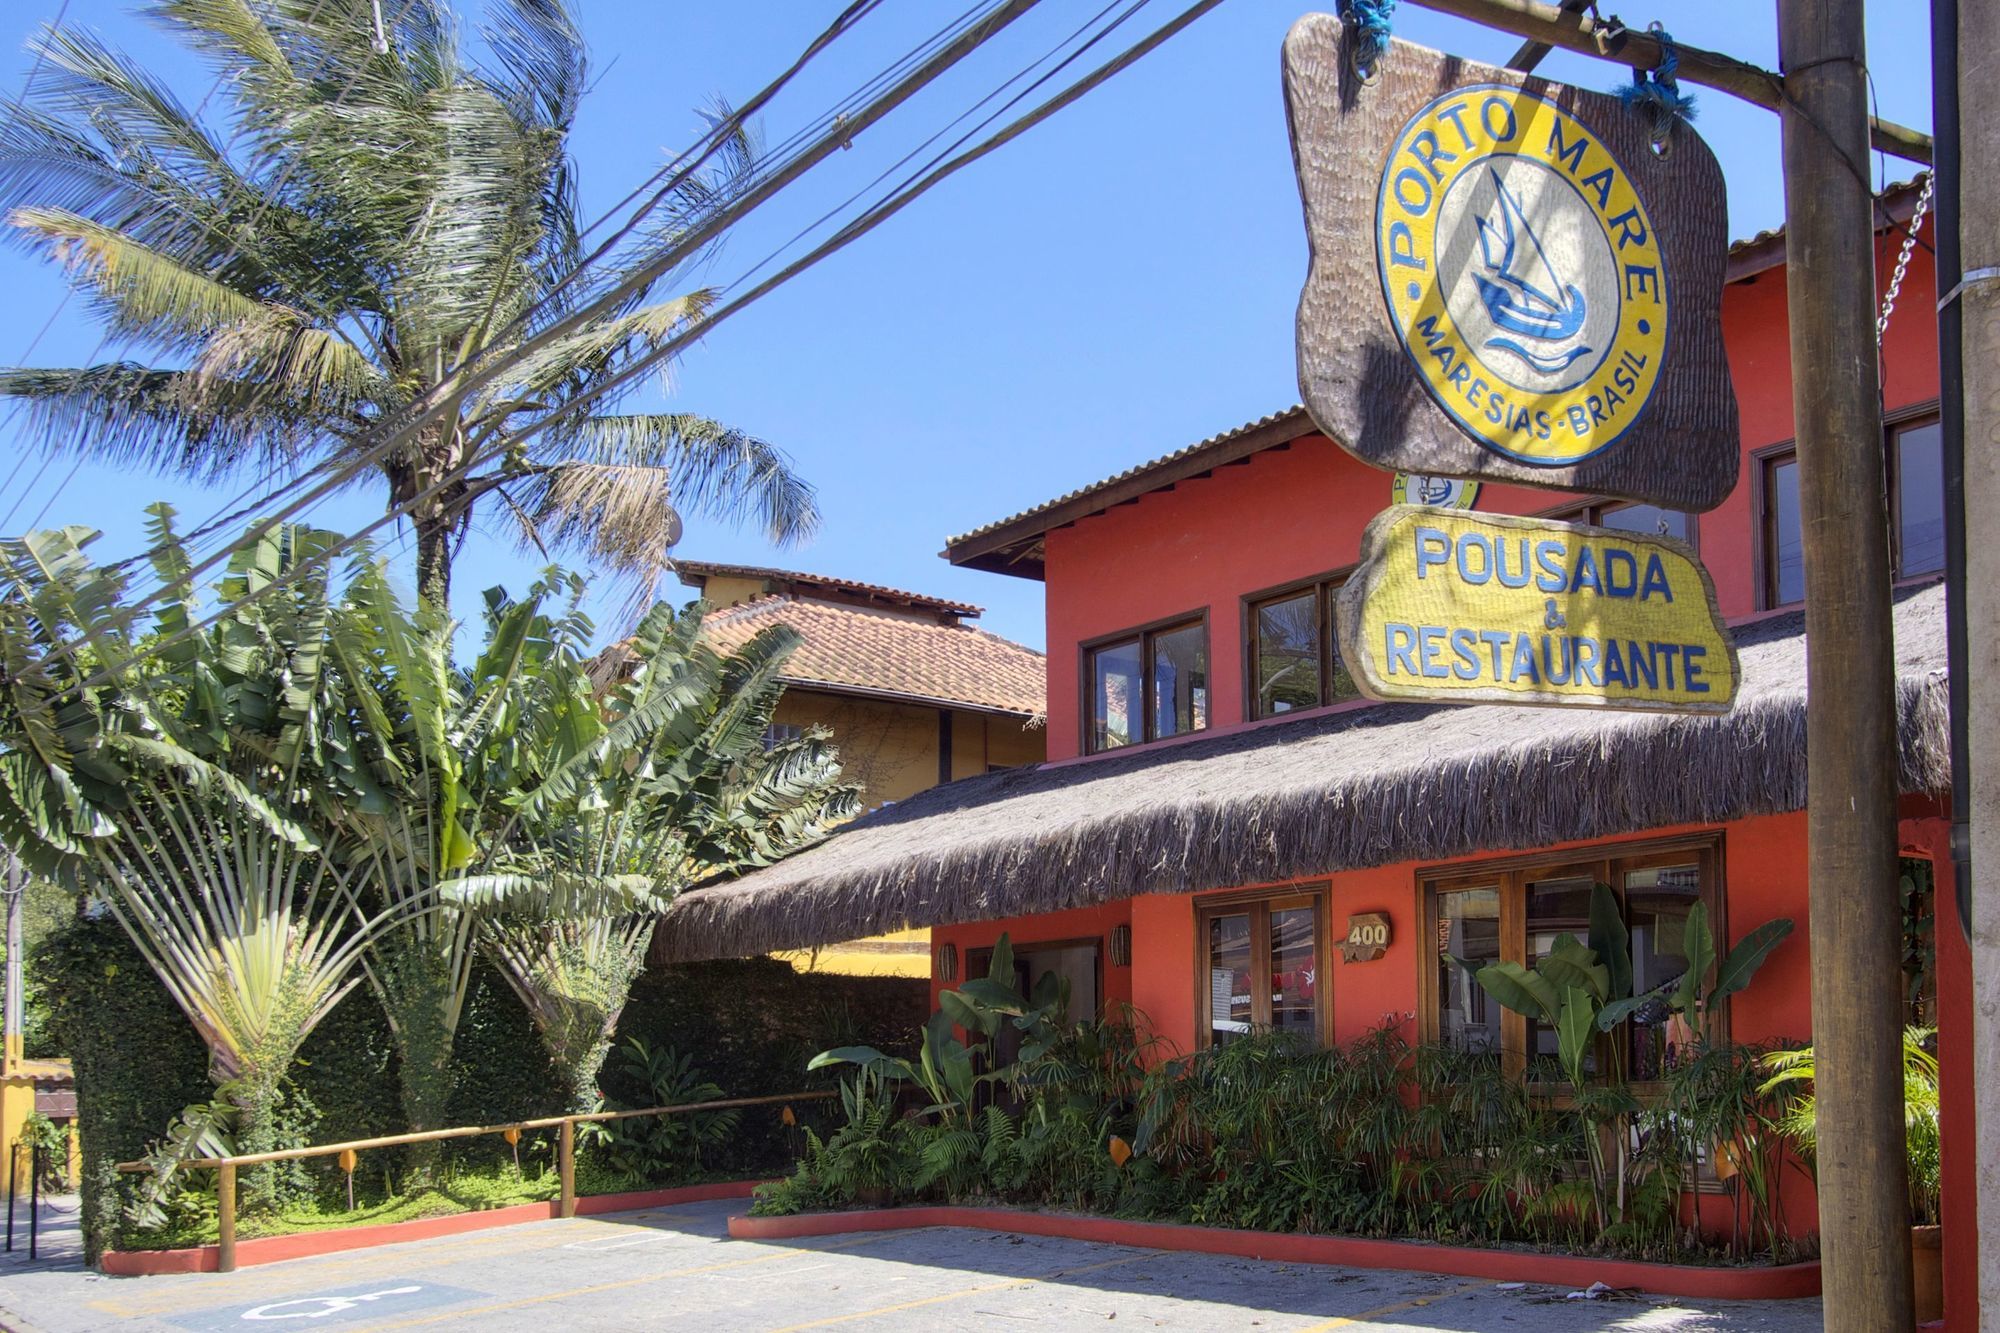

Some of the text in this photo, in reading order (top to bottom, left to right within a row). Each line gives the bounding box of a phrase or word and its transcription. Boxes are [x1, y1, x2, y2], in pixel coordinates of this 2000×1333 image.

[1390, 96, 1661, 305] PORTO MARE
[1416, 315, 1648, 440] MARESIAS BRASIL
[1414, 526, 1674, 603] POUSADA
[1544, 597, 1567, 630] &
[1385, 624, 1710, 692] RESTAURANTE
[1349, 925, 1387, 946] 400
